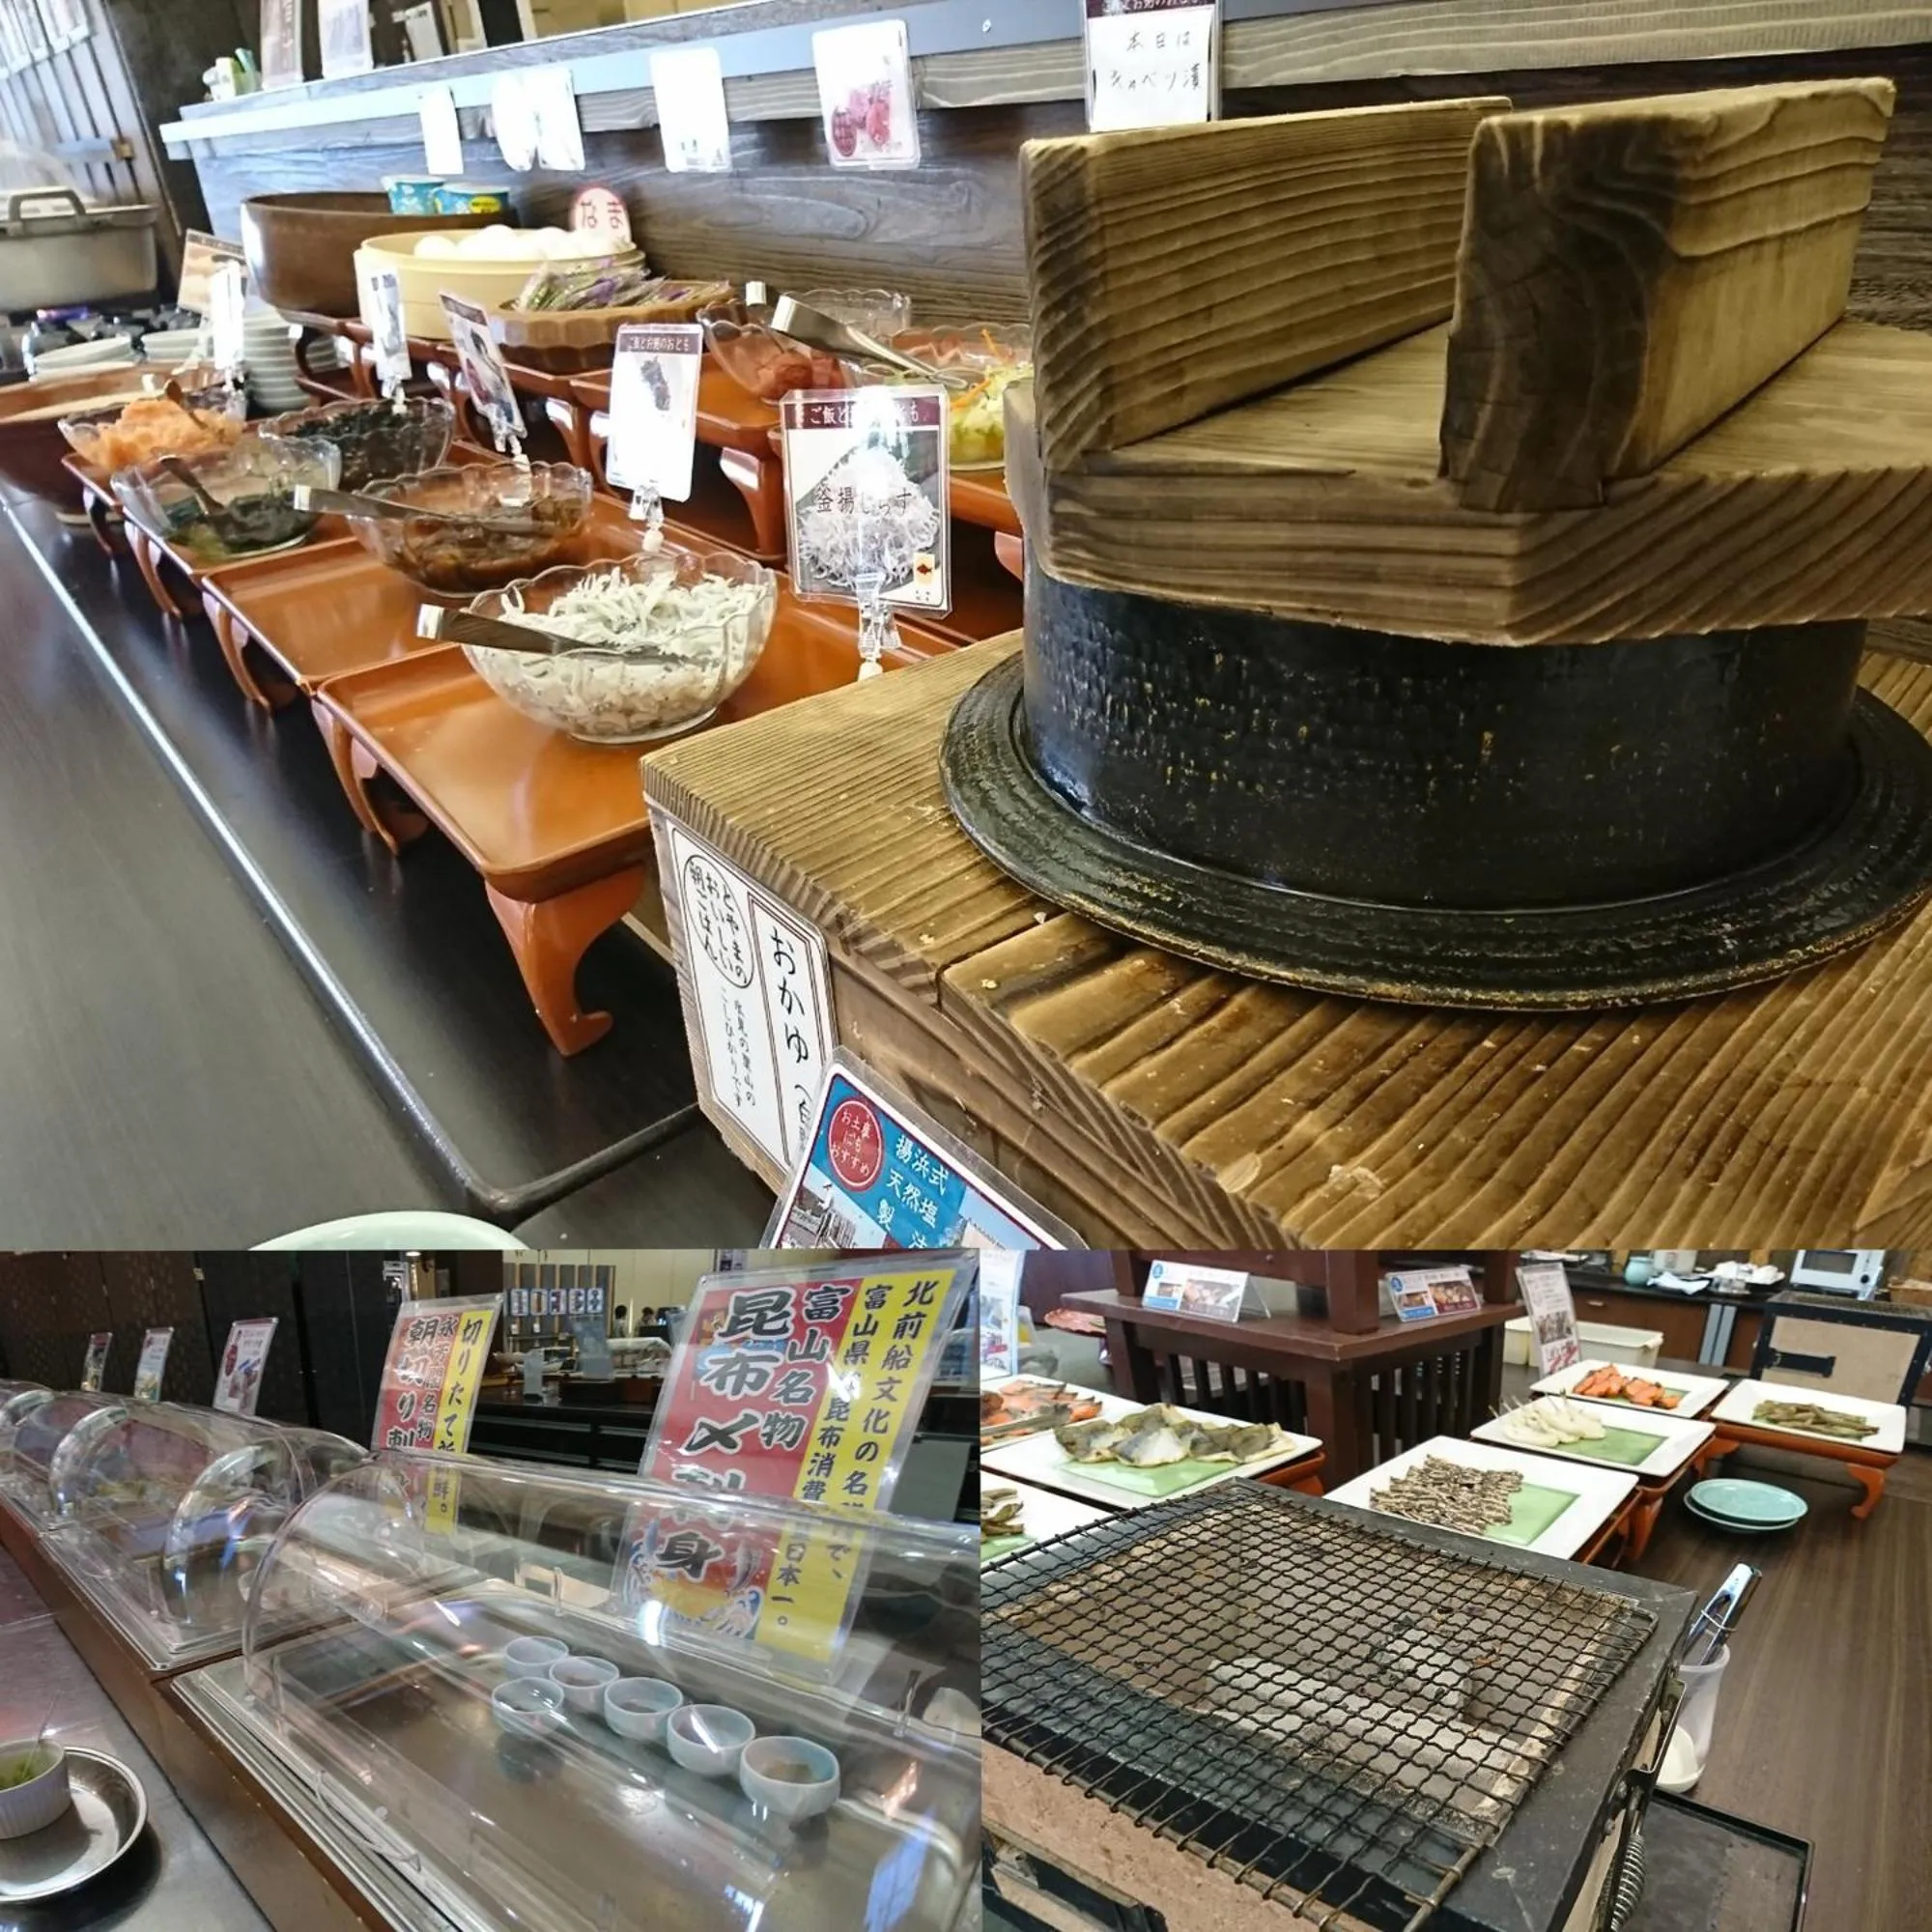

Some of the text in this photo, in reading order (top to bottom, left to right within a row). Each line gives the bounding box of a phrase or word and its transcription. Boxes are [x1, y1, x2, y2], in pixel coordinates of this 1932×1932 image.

[1126, 31, 1190, 51] 本日は
[810, 400, 920, 426] ご飯ととも
[689, 861, 718, 960] 朝ごはん
[706, 872, 734, 972] おいしい
[723, 884, 748, 983] とやまの
[830, 1143, 869, 1177] おすすめ
[886, 1168, 939, 1230] 天然塩
[895, 1134, 950, 1197] 揚浜式
[389, 1318, 439, 1454] 朝切り刺
[759, 1285, 852, 1449] 富山名物
[770, 1284, 895, 1627] 富山県昆布消費日本一。
[826, 1279, 941, 1579] 北前船文化の名で、
